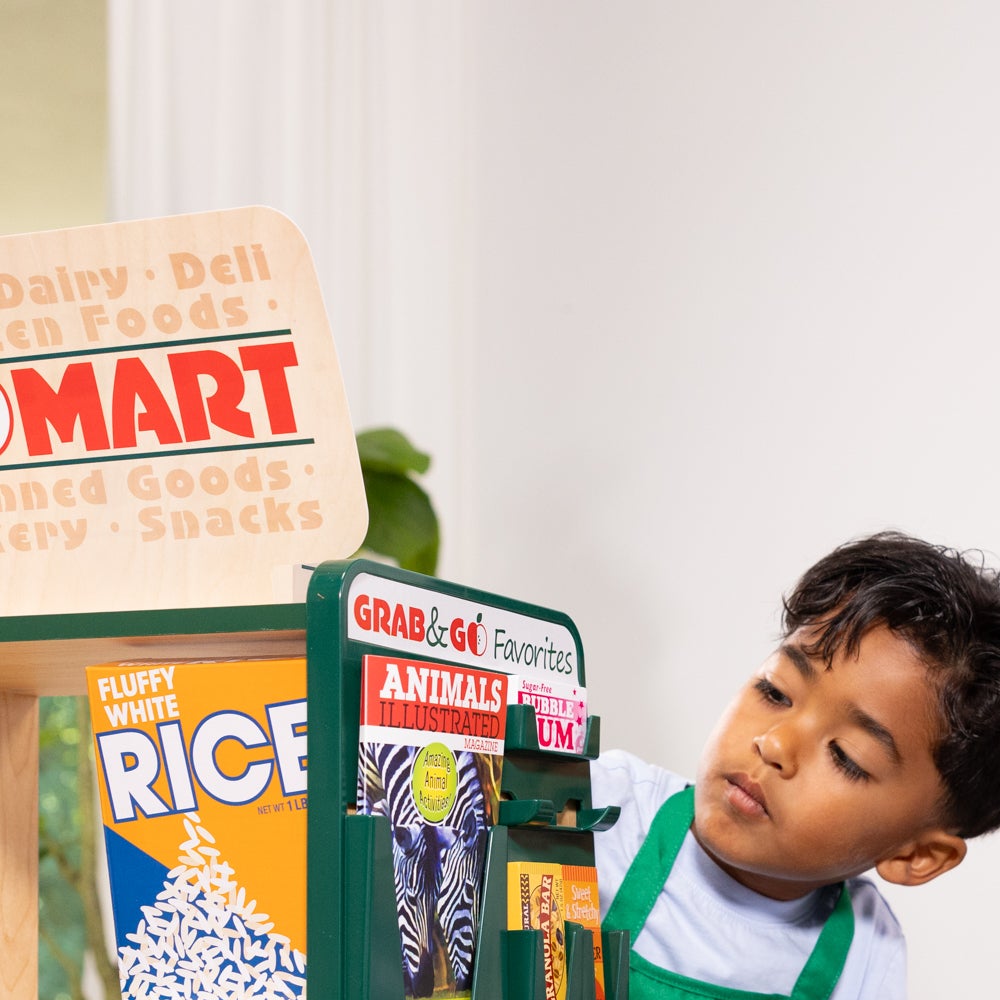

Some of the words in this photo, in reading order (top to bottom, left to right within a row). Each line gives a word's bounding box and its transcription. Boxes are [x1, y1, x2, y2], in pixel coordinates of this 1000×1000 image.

[0, 265, 128, 309] Dairy
[168, 243, 272, 290] Deli
[0, 316, 63, 351] en
[80, 293, 249, 342] Foods
[10, 341, 299, 457] MART
[127, 456, 292, 501] Goods
[0, 518, 87, 553] ery
[137, 498, 324, 542] Snacks
[494, 628, 573, 675] Favorites
[97, 666, 175, 701] FLUFFY
[380, 663, 502, 714] ANIMALS
[522, 680, 552, 694] Sugar-Free
[104, 694, 180, 727] WHITE
[379, 701, 500, 739] ILLUSTRATED
[464, 738, 499, 752] MAGAZINE
[537, 717, 575, 751] UM
[96, 698, 307, 824] RICE
[423, 751, 451, 773] Amazing
[425, 771, 448, 790] Animal
[258, 804, 271, 815] NET
[273, 802, 284, 812] WT
[287, 800, 292, 811] 1
[541, 875, 552, 915] BAR
[571, 884, 592, 903] Sweet
